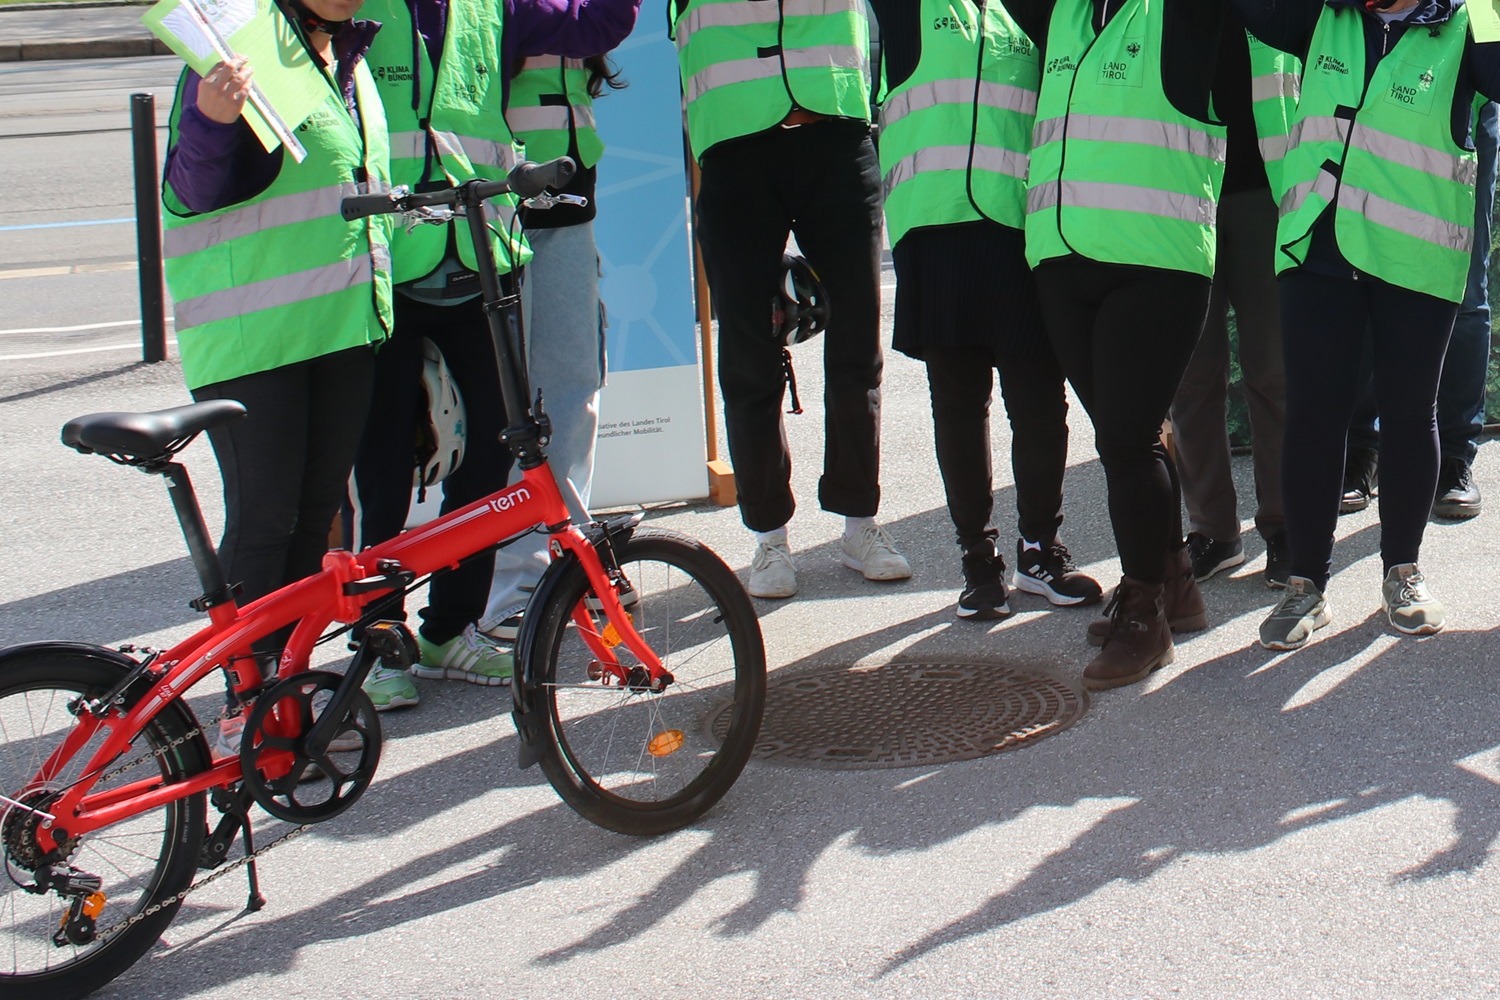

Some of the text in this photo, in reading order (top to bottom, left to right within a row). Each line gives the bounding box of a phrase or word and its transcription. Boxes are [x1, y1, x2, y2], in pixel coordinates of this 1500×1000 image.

[1008, 36, 1031, 48] LAND
[1008, 44, 1032, 56] TIROL
[1103, 62, 1127, 72] LAND
[1325, 56, 1345, 68] KLIMA
[386, 66, 410, 74] KLIMA
[1322, 62, 1350, 75] BÜNDNIS
[388, 73, 413, 82] BÜNDN
[1102, 70, 1127, 80] TIROL
[1392, 82, 1417, 96] LAND
[1390, 88, 1416, 104] TIROL
[632, 418, 655, 426] Landes
[656, 416, 671, 424] Tirol
[490, 488, 531, 513] tern
